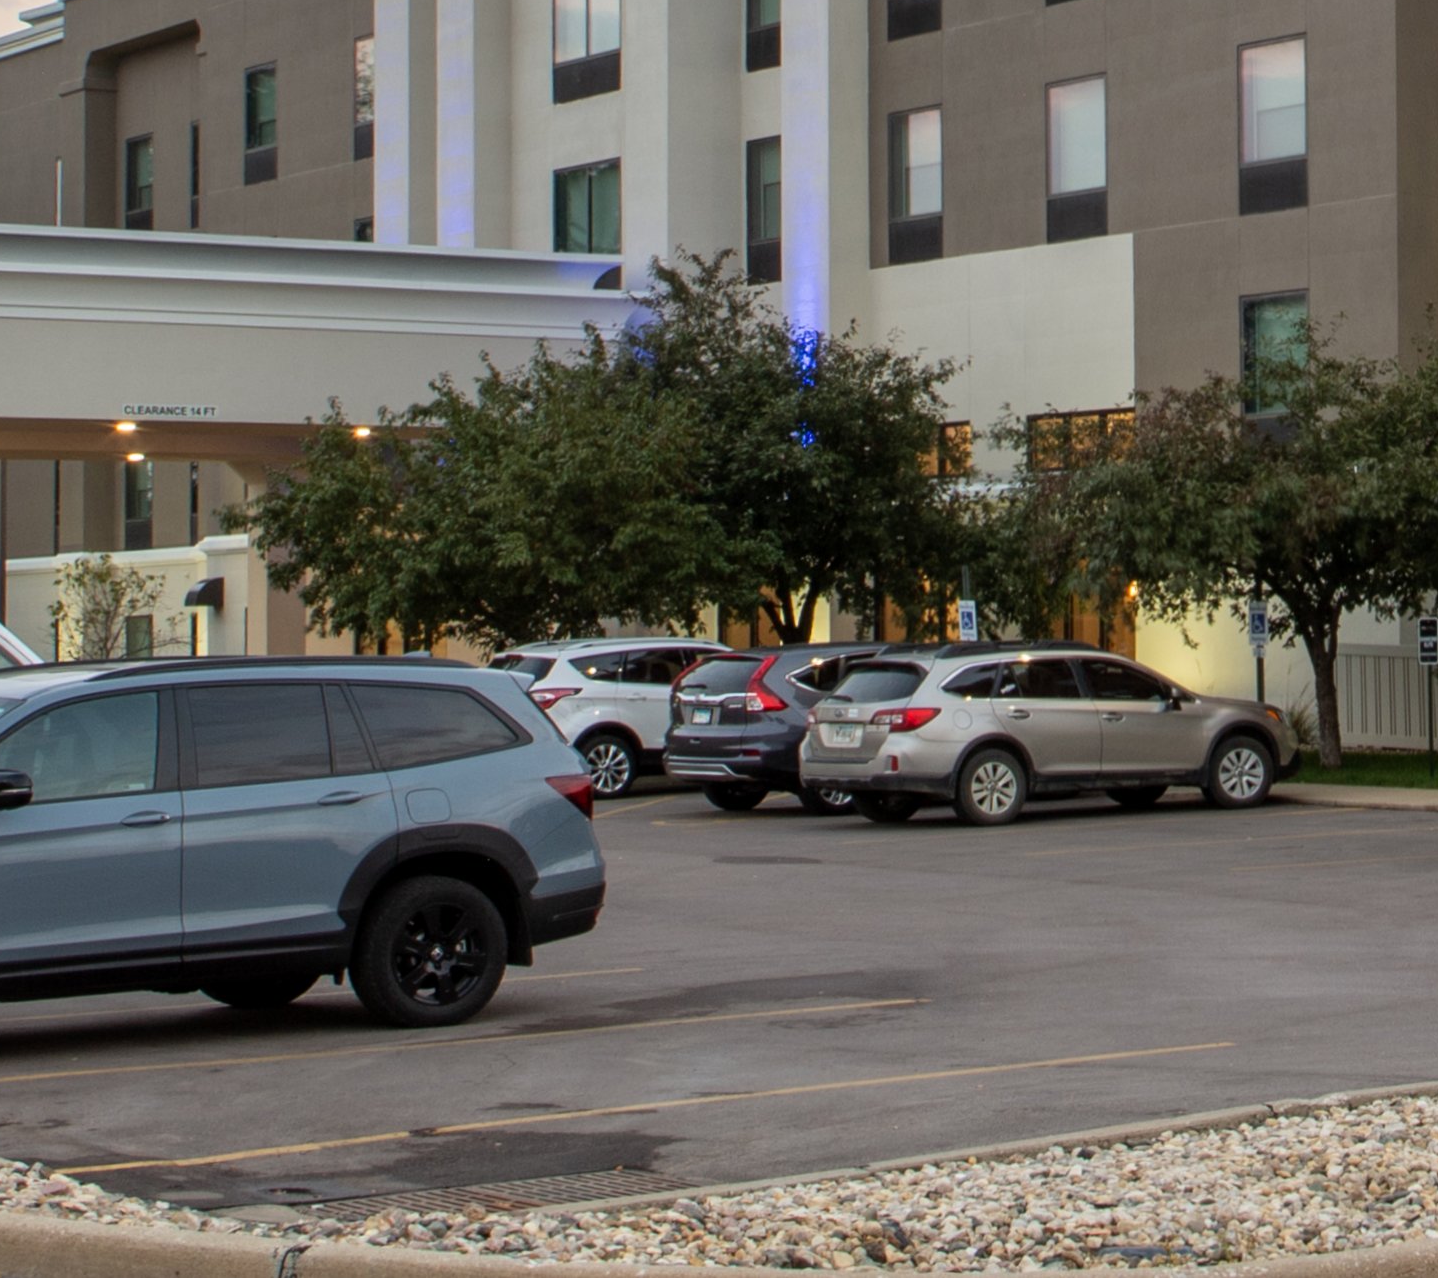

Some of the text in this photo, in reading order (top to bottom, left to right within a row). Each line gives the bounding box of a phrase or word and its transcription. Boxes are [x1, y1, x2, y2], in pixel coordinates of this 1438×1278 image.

[123, 405, 217, 416] CLEARANCE 14 FT
